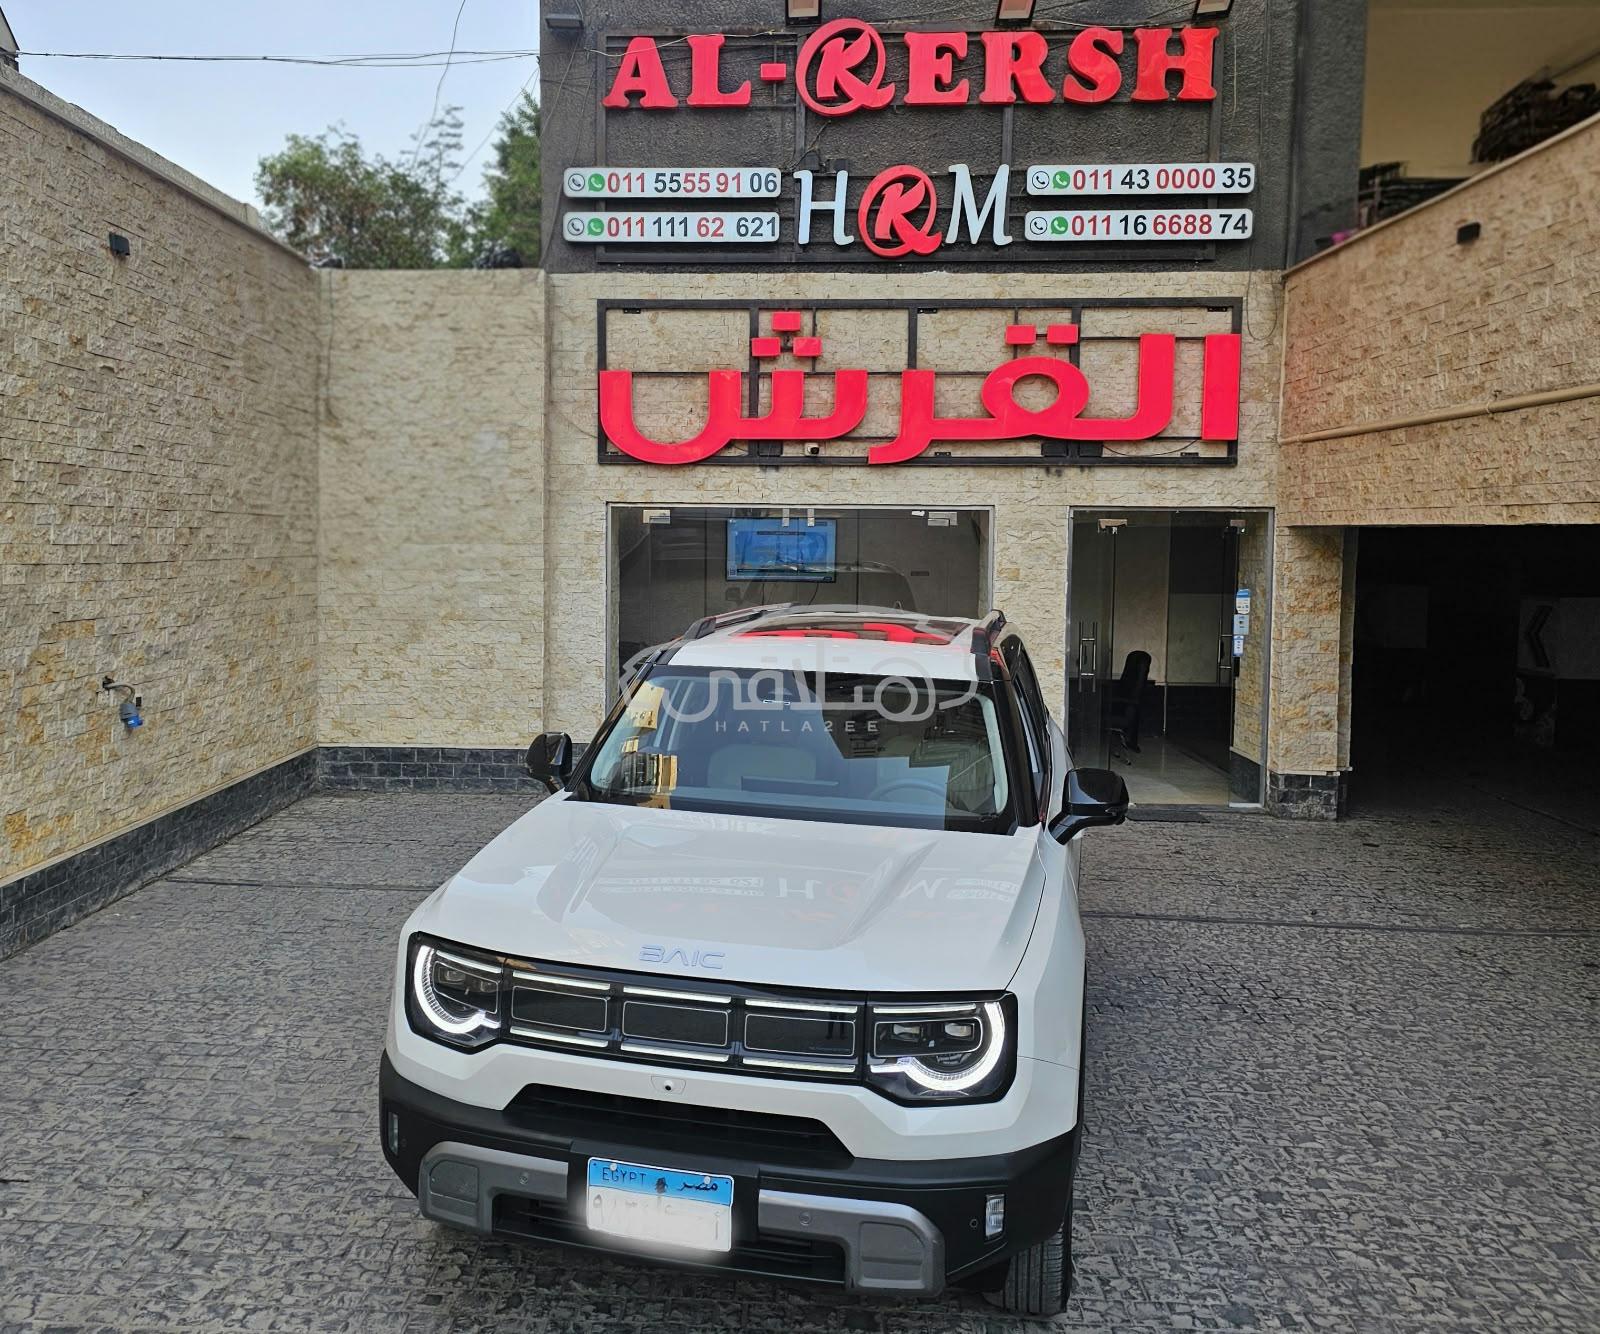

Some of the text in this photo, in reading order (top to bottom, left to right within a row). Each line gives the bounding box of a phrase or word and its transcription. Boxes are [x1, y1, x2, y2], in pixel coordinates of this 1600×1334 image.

[607, 172, 645, 193] 011
[750, 172, 777, 193] 06
[1073, 168, 1251, 190] 011 43 0000 35
[607, 216, 776, 237] 011 111 62 621
[1071, 213, 1248, 235] 011 16 6688 74
[599, 311, 1242, 465] القرش
[639, 944, 726, 970] BAIC
[602, 1167, 646, 1184] EGYPT
[677, 1180, 719, 1193] مصر
